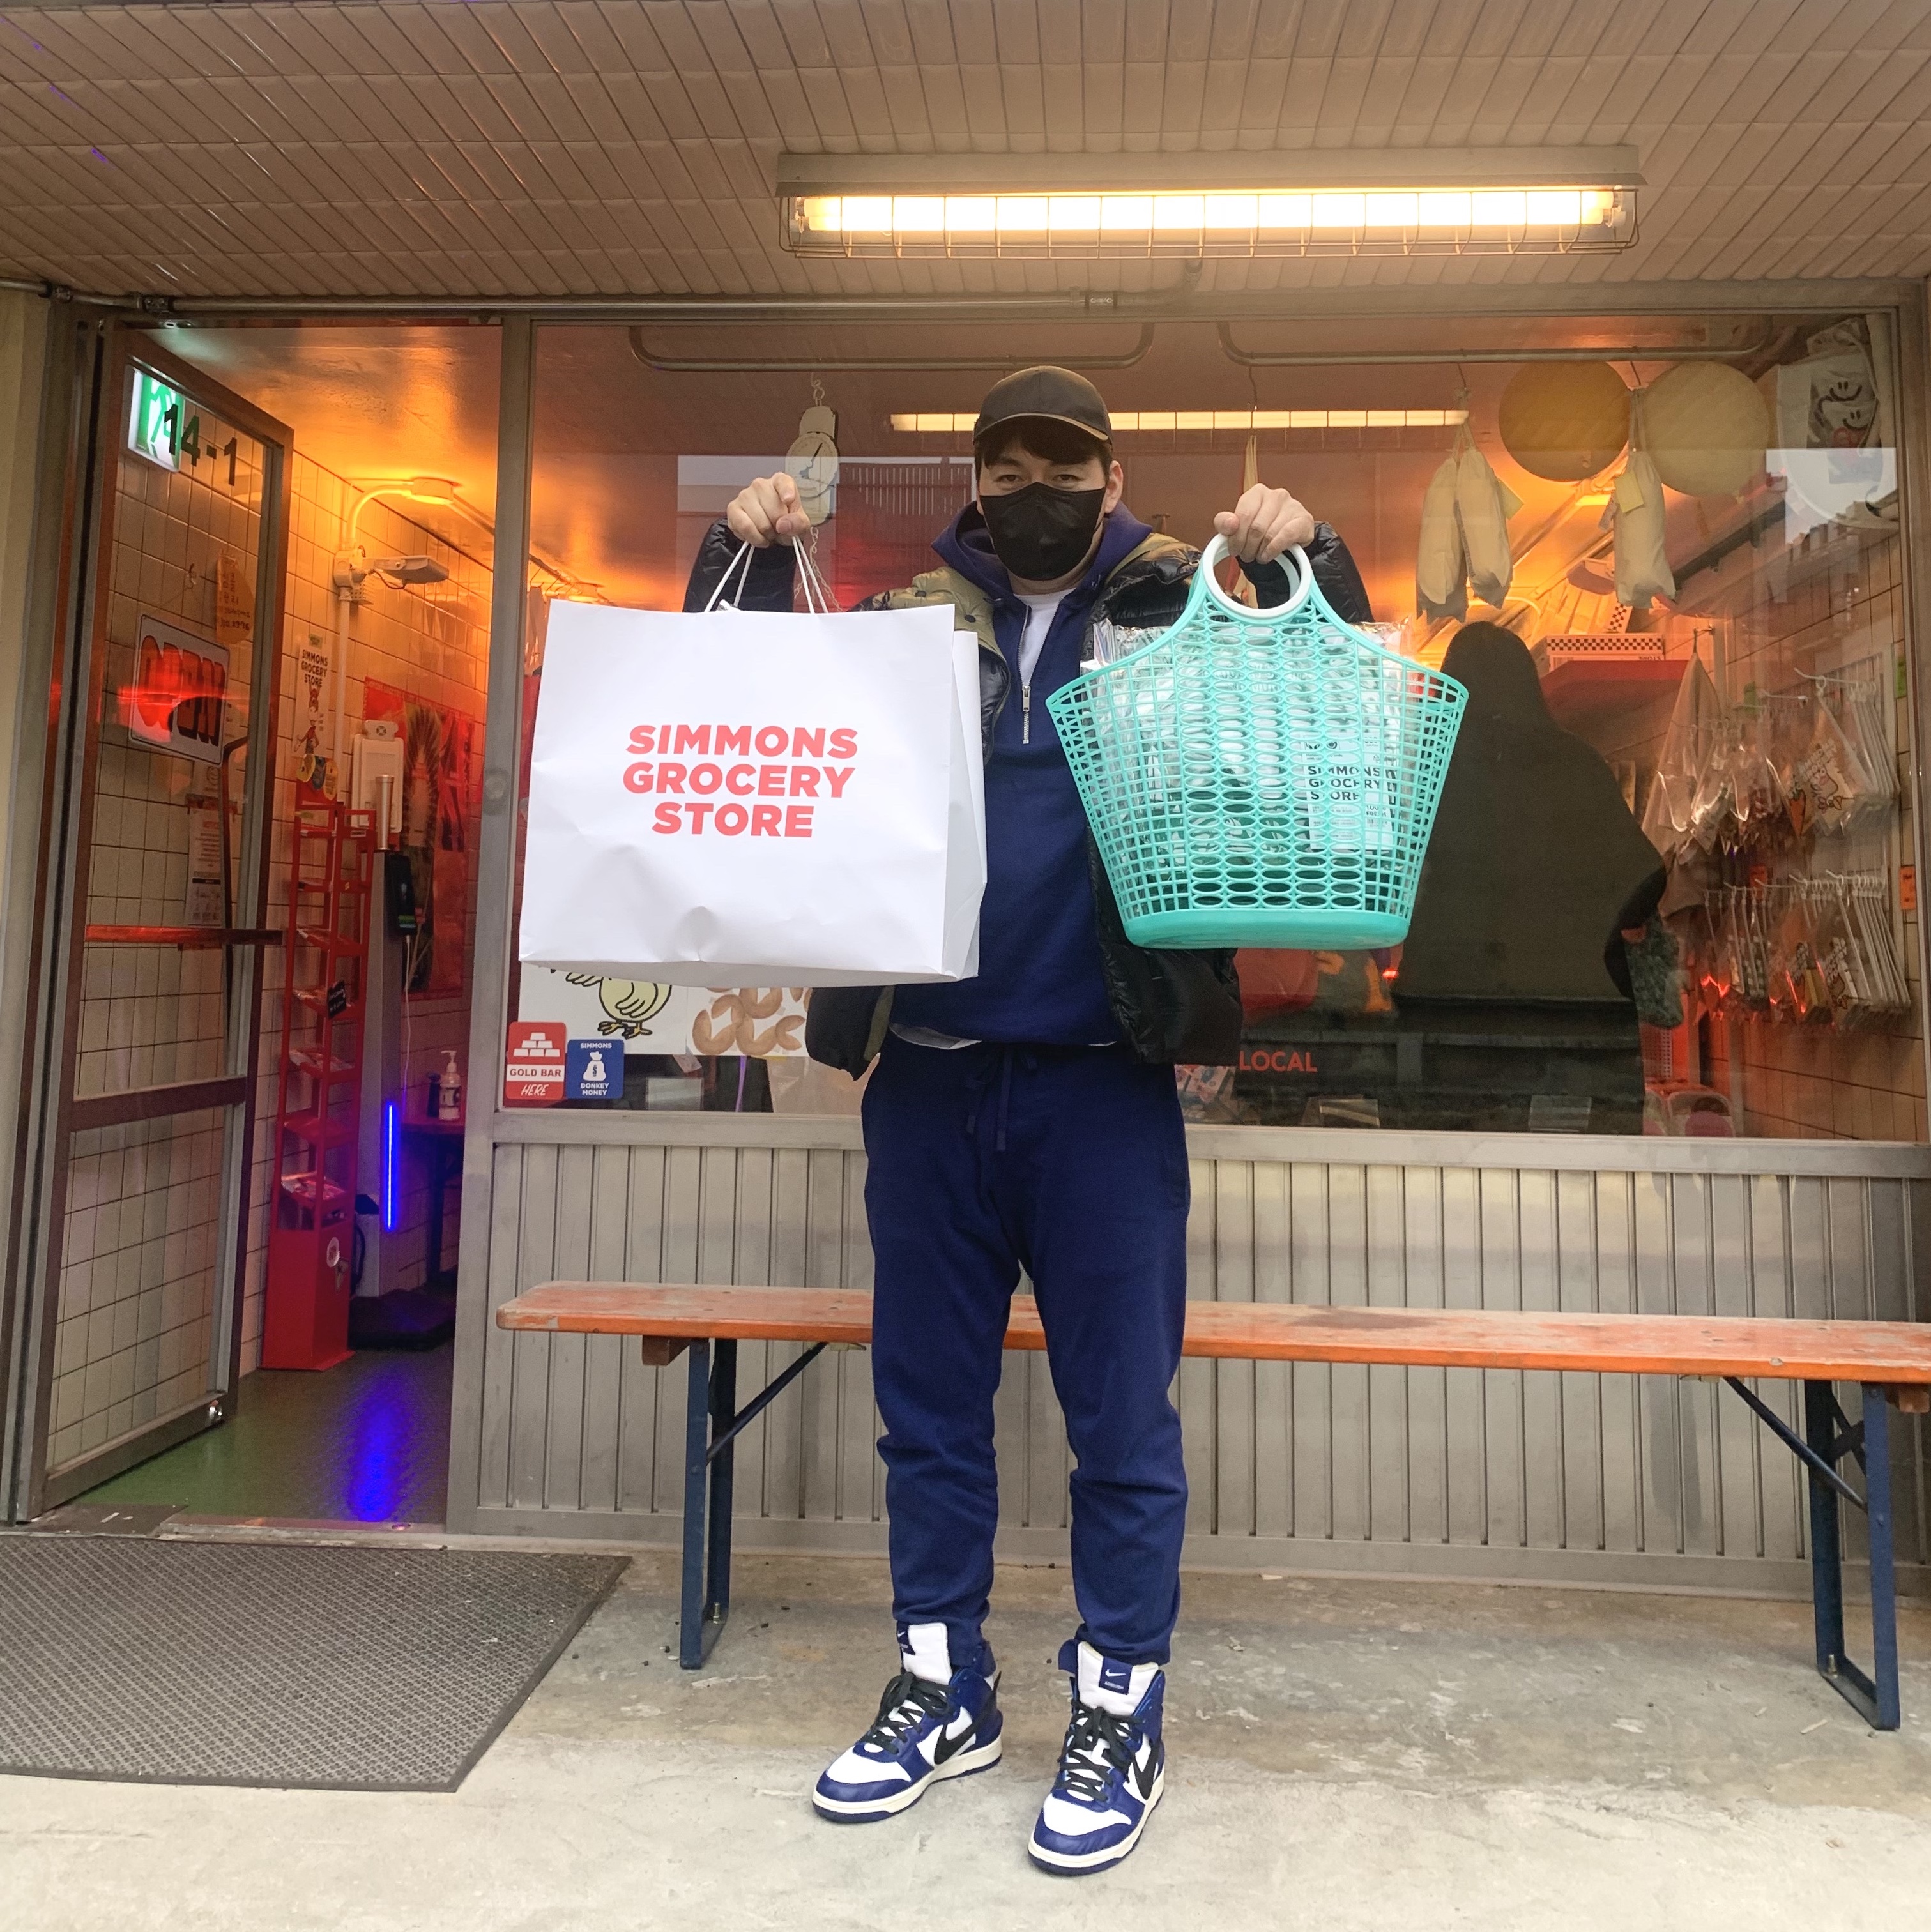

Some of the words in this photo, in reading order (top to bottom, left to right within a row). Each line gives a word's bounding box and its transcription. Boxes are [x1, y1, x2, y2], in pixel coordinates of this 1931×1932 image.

[164, 403, 237, 487] 14-1
[301, 649, 328, 667] SIMMONS
[301, 660, 328, 678] GROCERY
[304, 673, 323, 688] STORE
[625, 724, 858, 759] SIMMONS
[623, 761, 856, 798] GROCERY
[1309, 779, 1380, 789] GOCERY
[1310, 791, 1360, 801] SORE
[651, 801, 814, 838] STORE
[1239, 1050, 1318, 1072] LOCAL
[510, 1069, 537, 1077] GOLD
[521, 1084, 550, 1096] HERE
